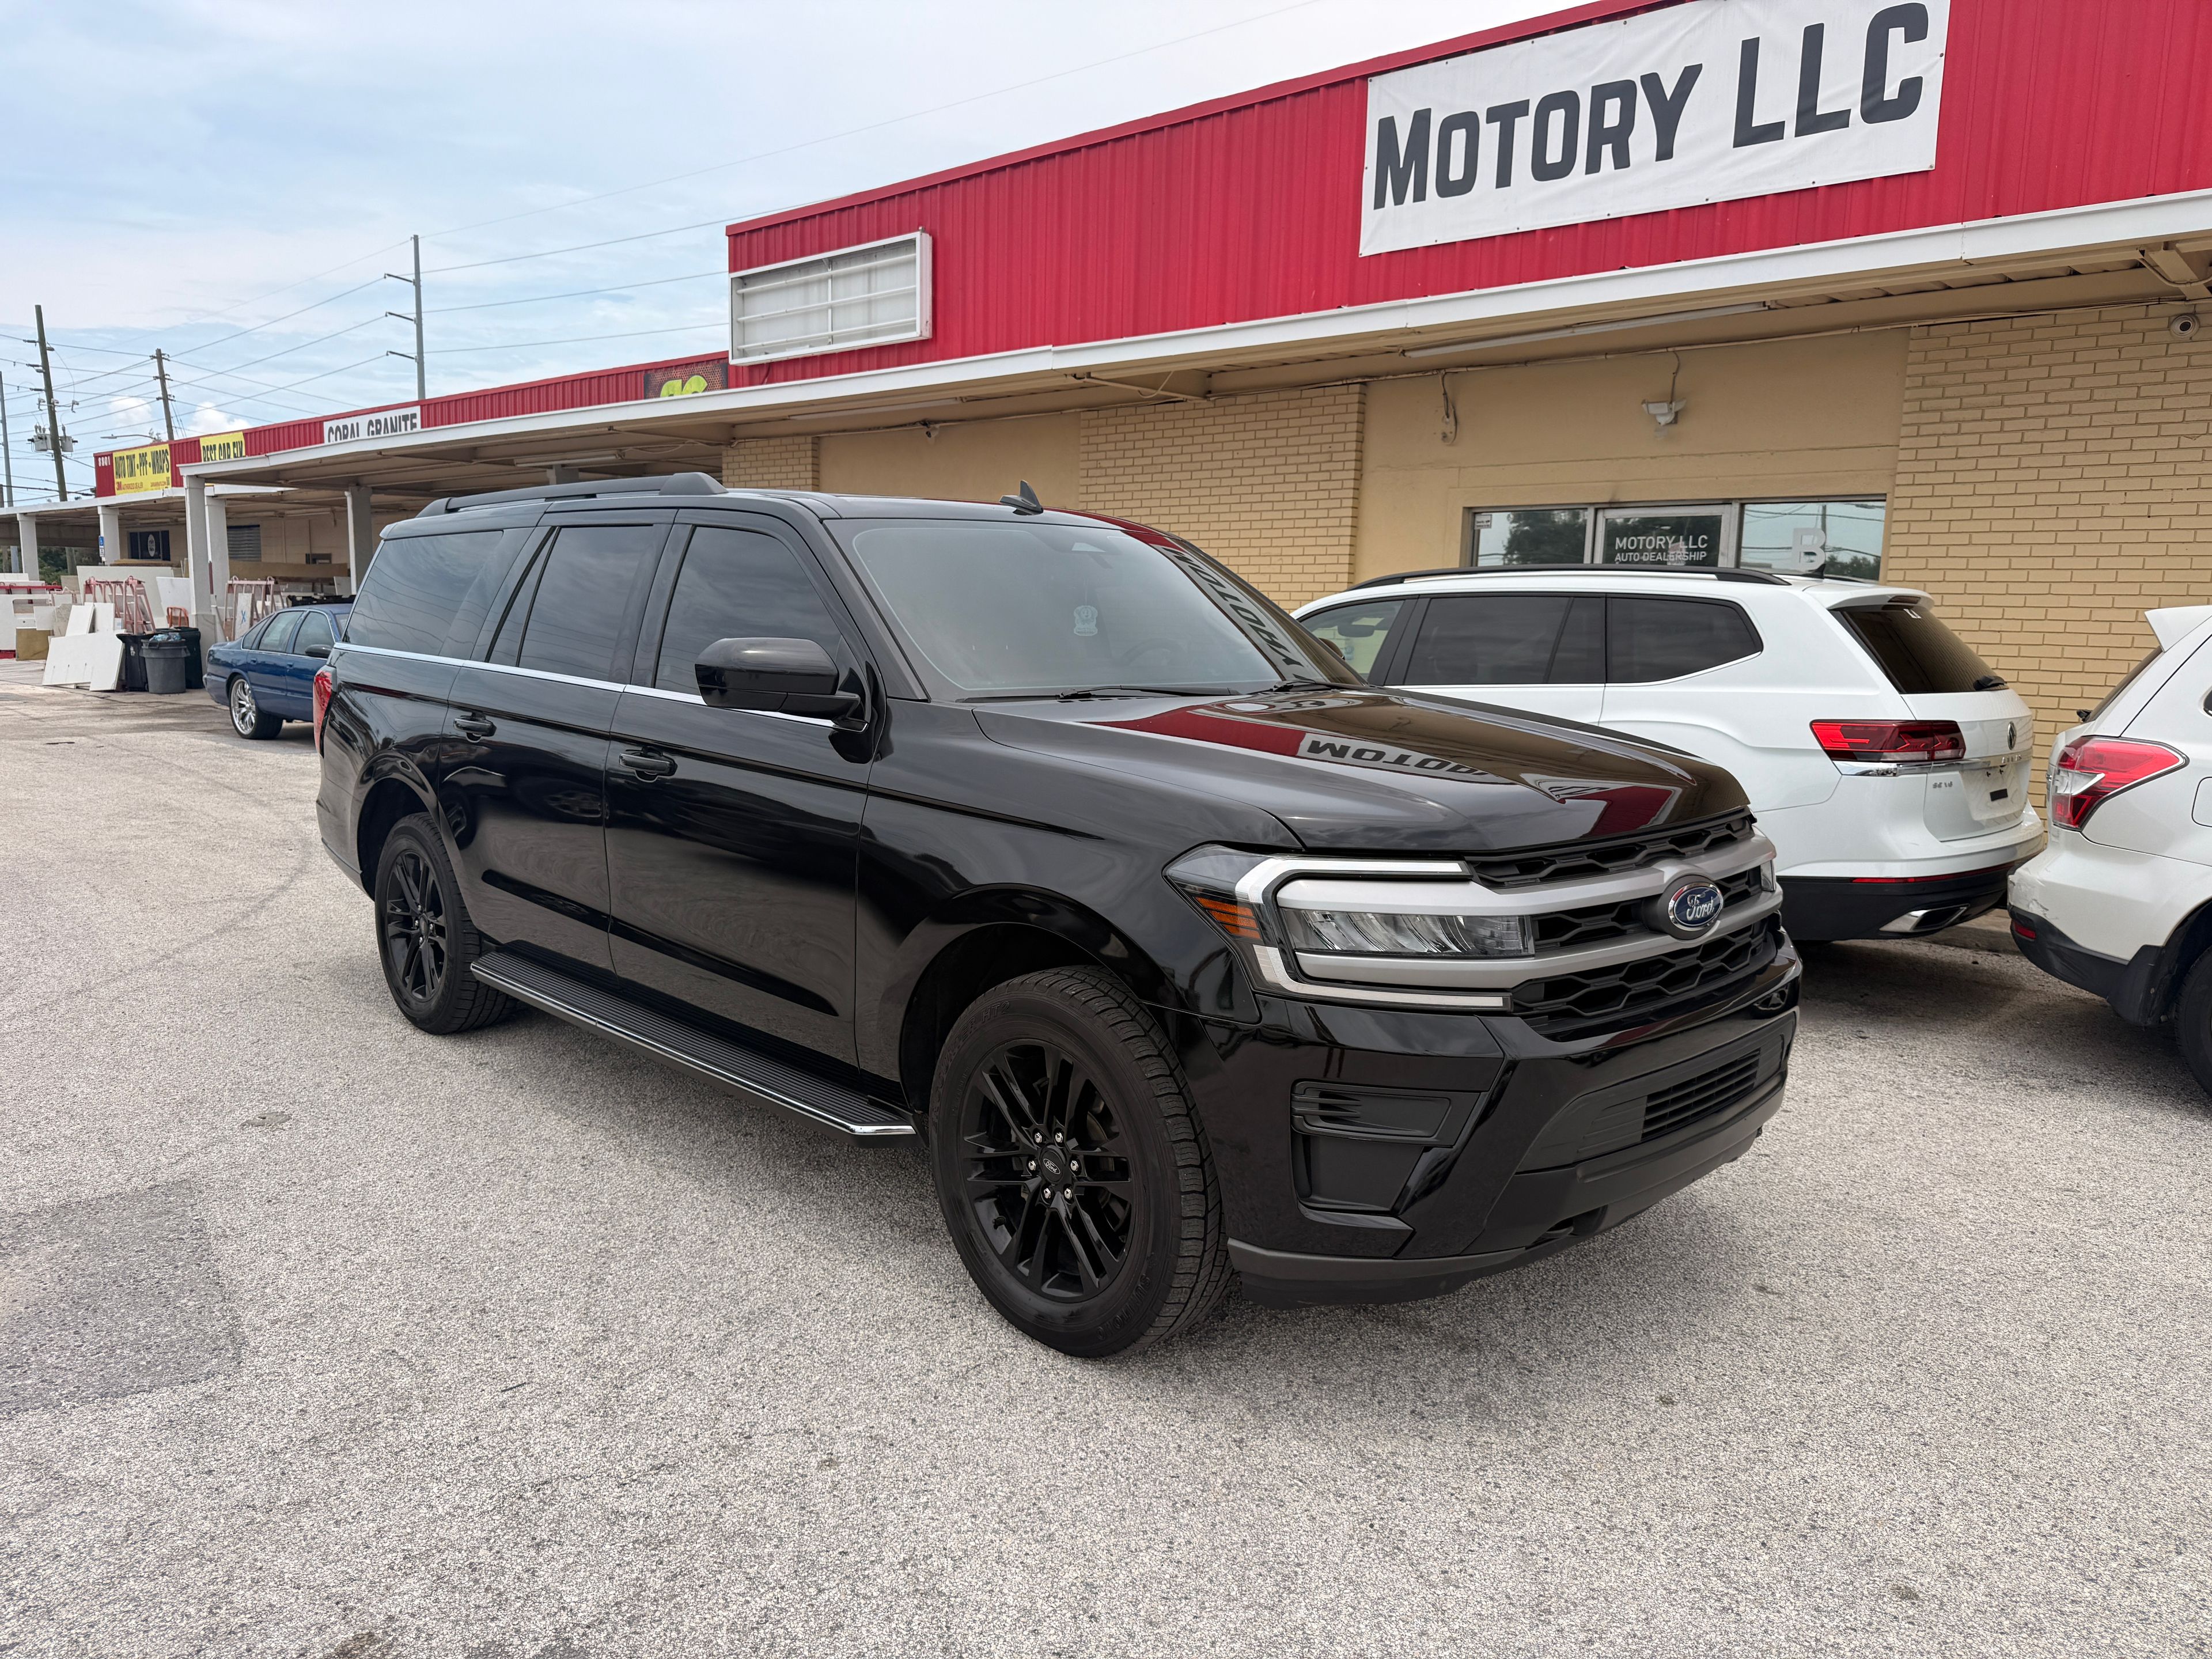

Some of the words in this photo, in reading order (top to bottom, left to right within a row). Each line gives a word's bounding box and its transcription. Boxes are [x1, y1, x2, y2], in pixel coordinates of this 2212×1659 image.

[1374, 63, 1702, 210] MOTORY
[1733, 2, 1929, 148] LLC
[367, 413, 417, 437] GRANITE
[115, 456, 126, 479] AUTO
[126, 454, 136, 478] TINT
[138, 452, 148, 476] PPF
[150, 449, 169, 475] WRAPS
[1615, 536, 1676, 550] MOTORY
[1679, 535, 1708, 548] LLC
[1615, 551, 1639, 562] AUTO
[1642, 551, 1707, 562] DEALERSHIP
[1687, 891, 1714, 921] Ford
